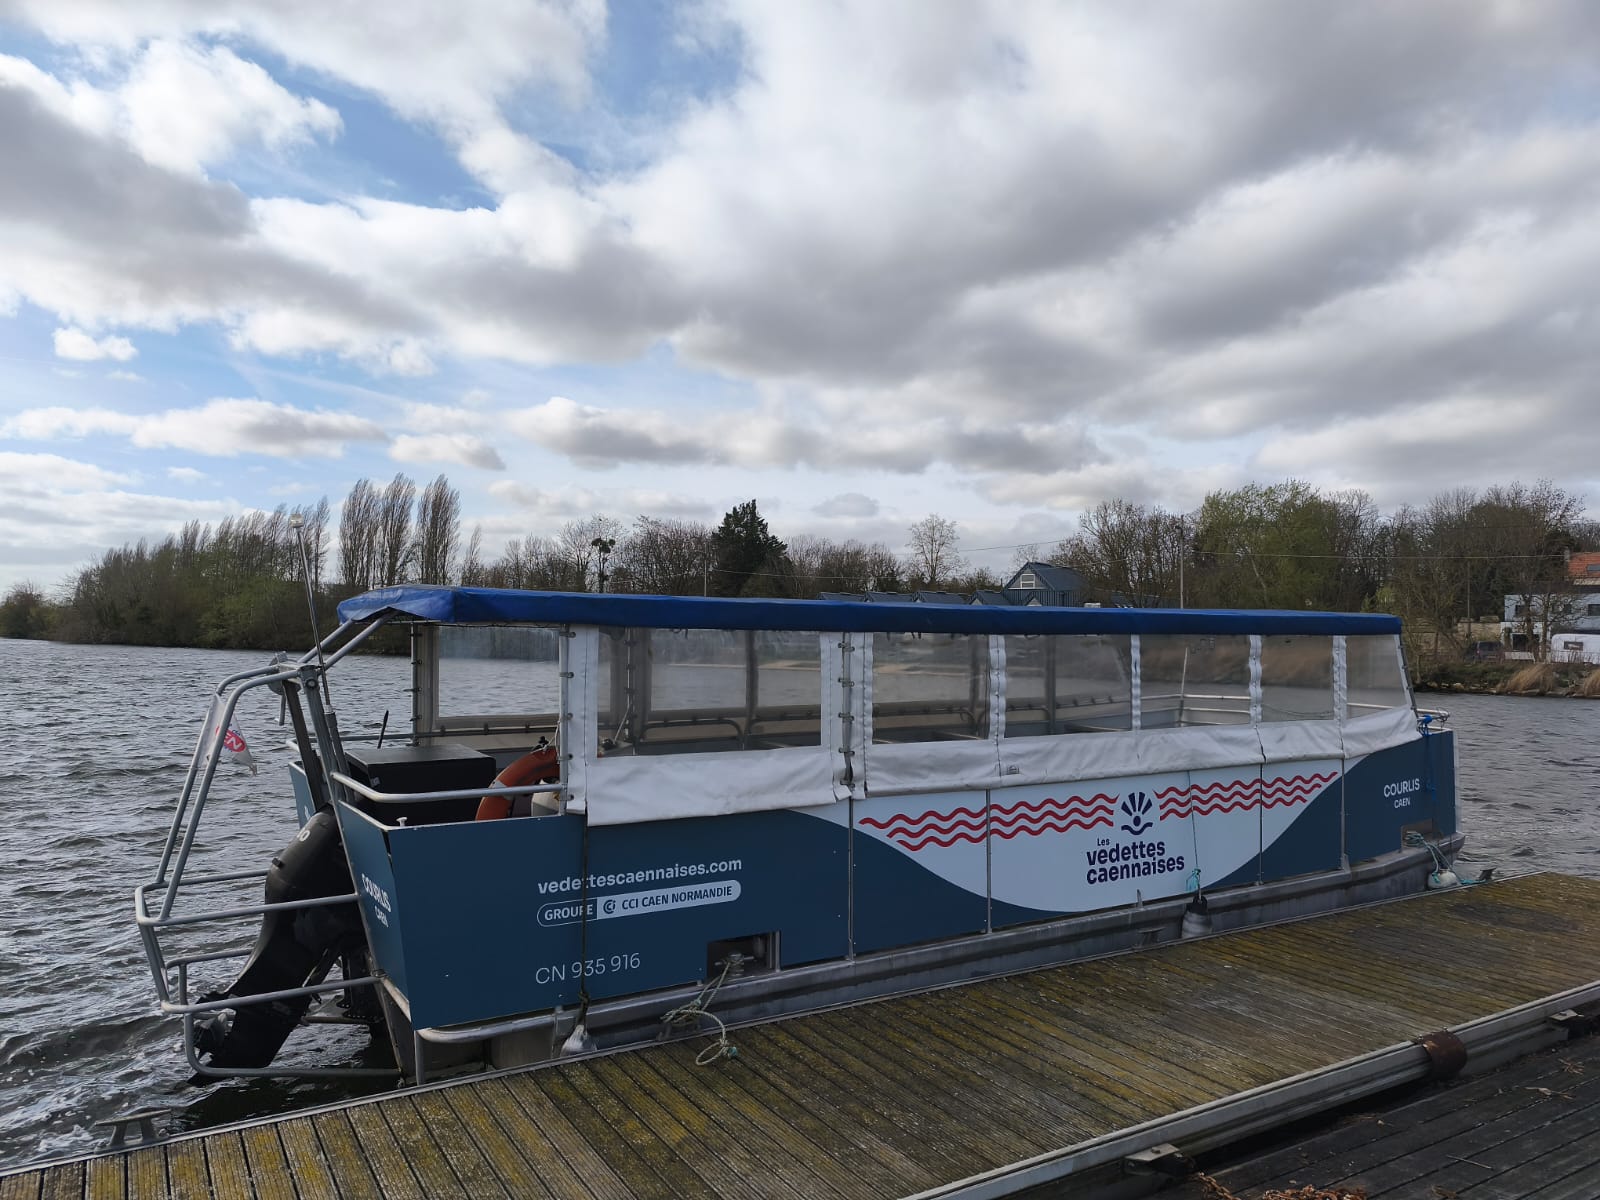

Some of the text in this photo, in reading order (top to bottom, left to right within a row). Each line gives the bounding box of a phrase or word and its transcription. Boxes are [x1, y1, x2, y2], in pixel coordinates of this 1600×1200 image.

[1384, 778, 1420, 797] COURLIS
[1394, 798, 1411, 808] CAEN
[1086, 841, 1165, 865] vedettes
[1097, 838, 1110, 846] Les
[1086, 856, 1184, 884] caennaises
[622, 895, 638, 910] CCI
[643, 893, 669, 907] CAEN
[671, 885, 732, 903] NORMANDIE
[535, 953, 641, 984] CN 935 916
